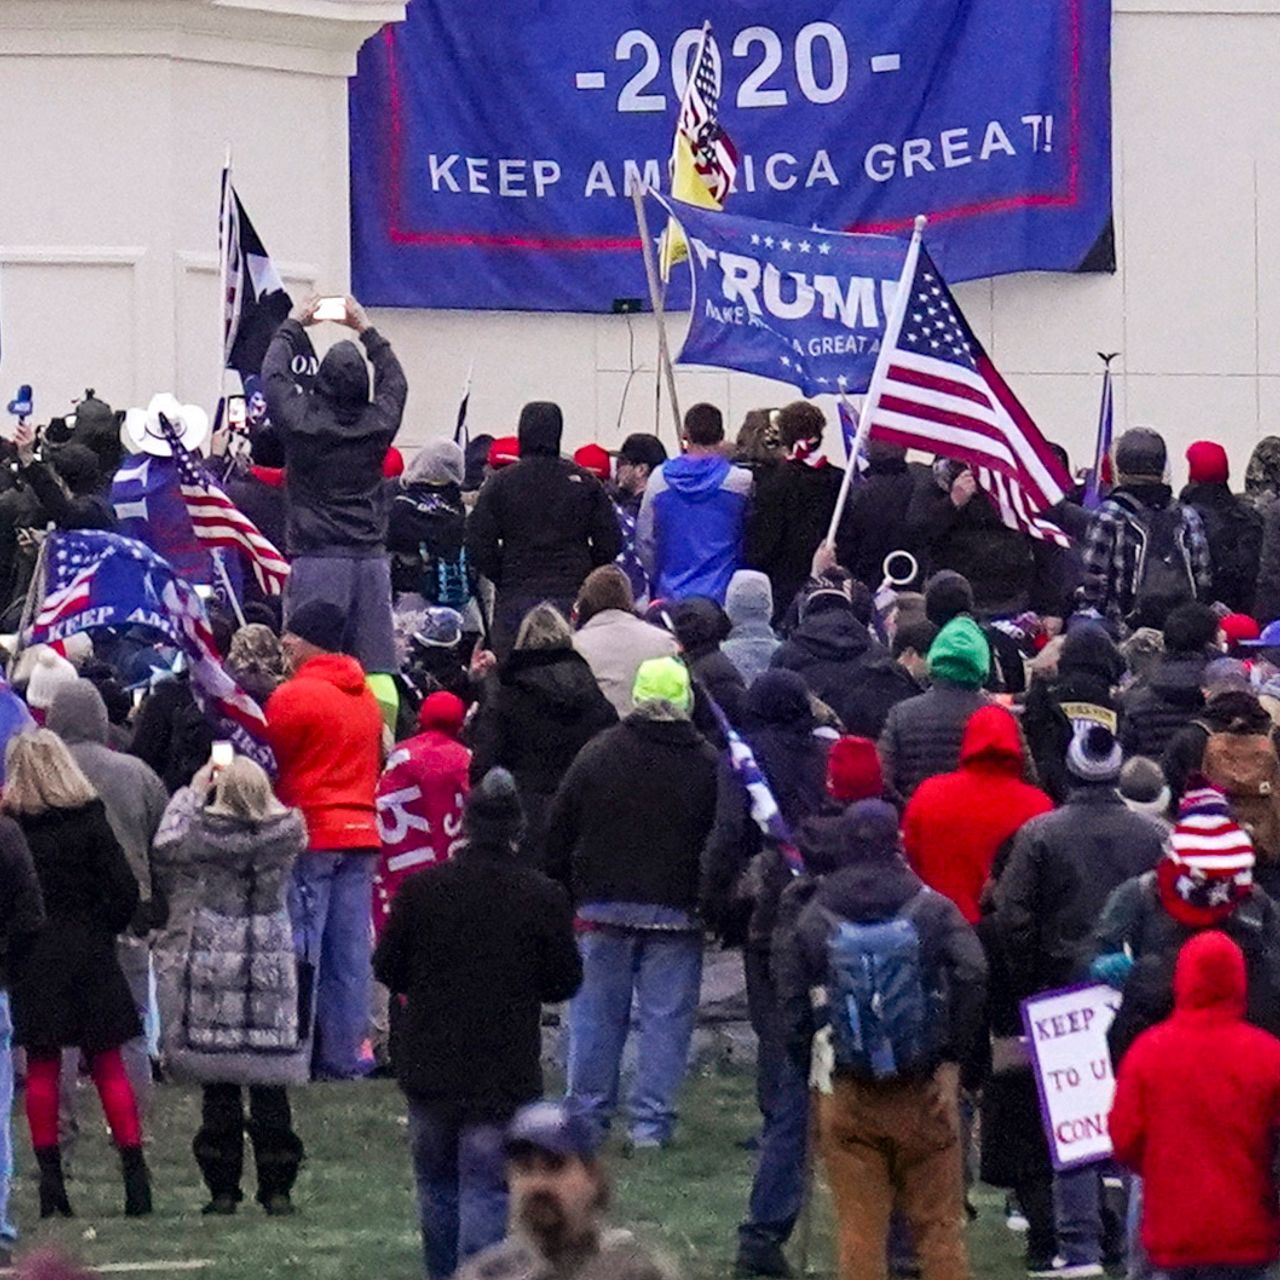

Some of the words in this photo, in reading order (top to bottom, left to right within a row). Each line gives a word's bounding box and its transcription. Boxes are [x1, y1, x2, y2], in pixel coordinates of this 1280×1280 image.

[429, 152, 562, 198] KEEP
[583, 149, 840, 198] AMICA
[863, 113, 1055, 184] GREAT!
[807, 334, 868, 357] GREAT
[48, 606, 114, 644] KEEP
[1034, 1007, 1096, 1042] KEEP
[1047, 1066, 1081, 1093] TO
